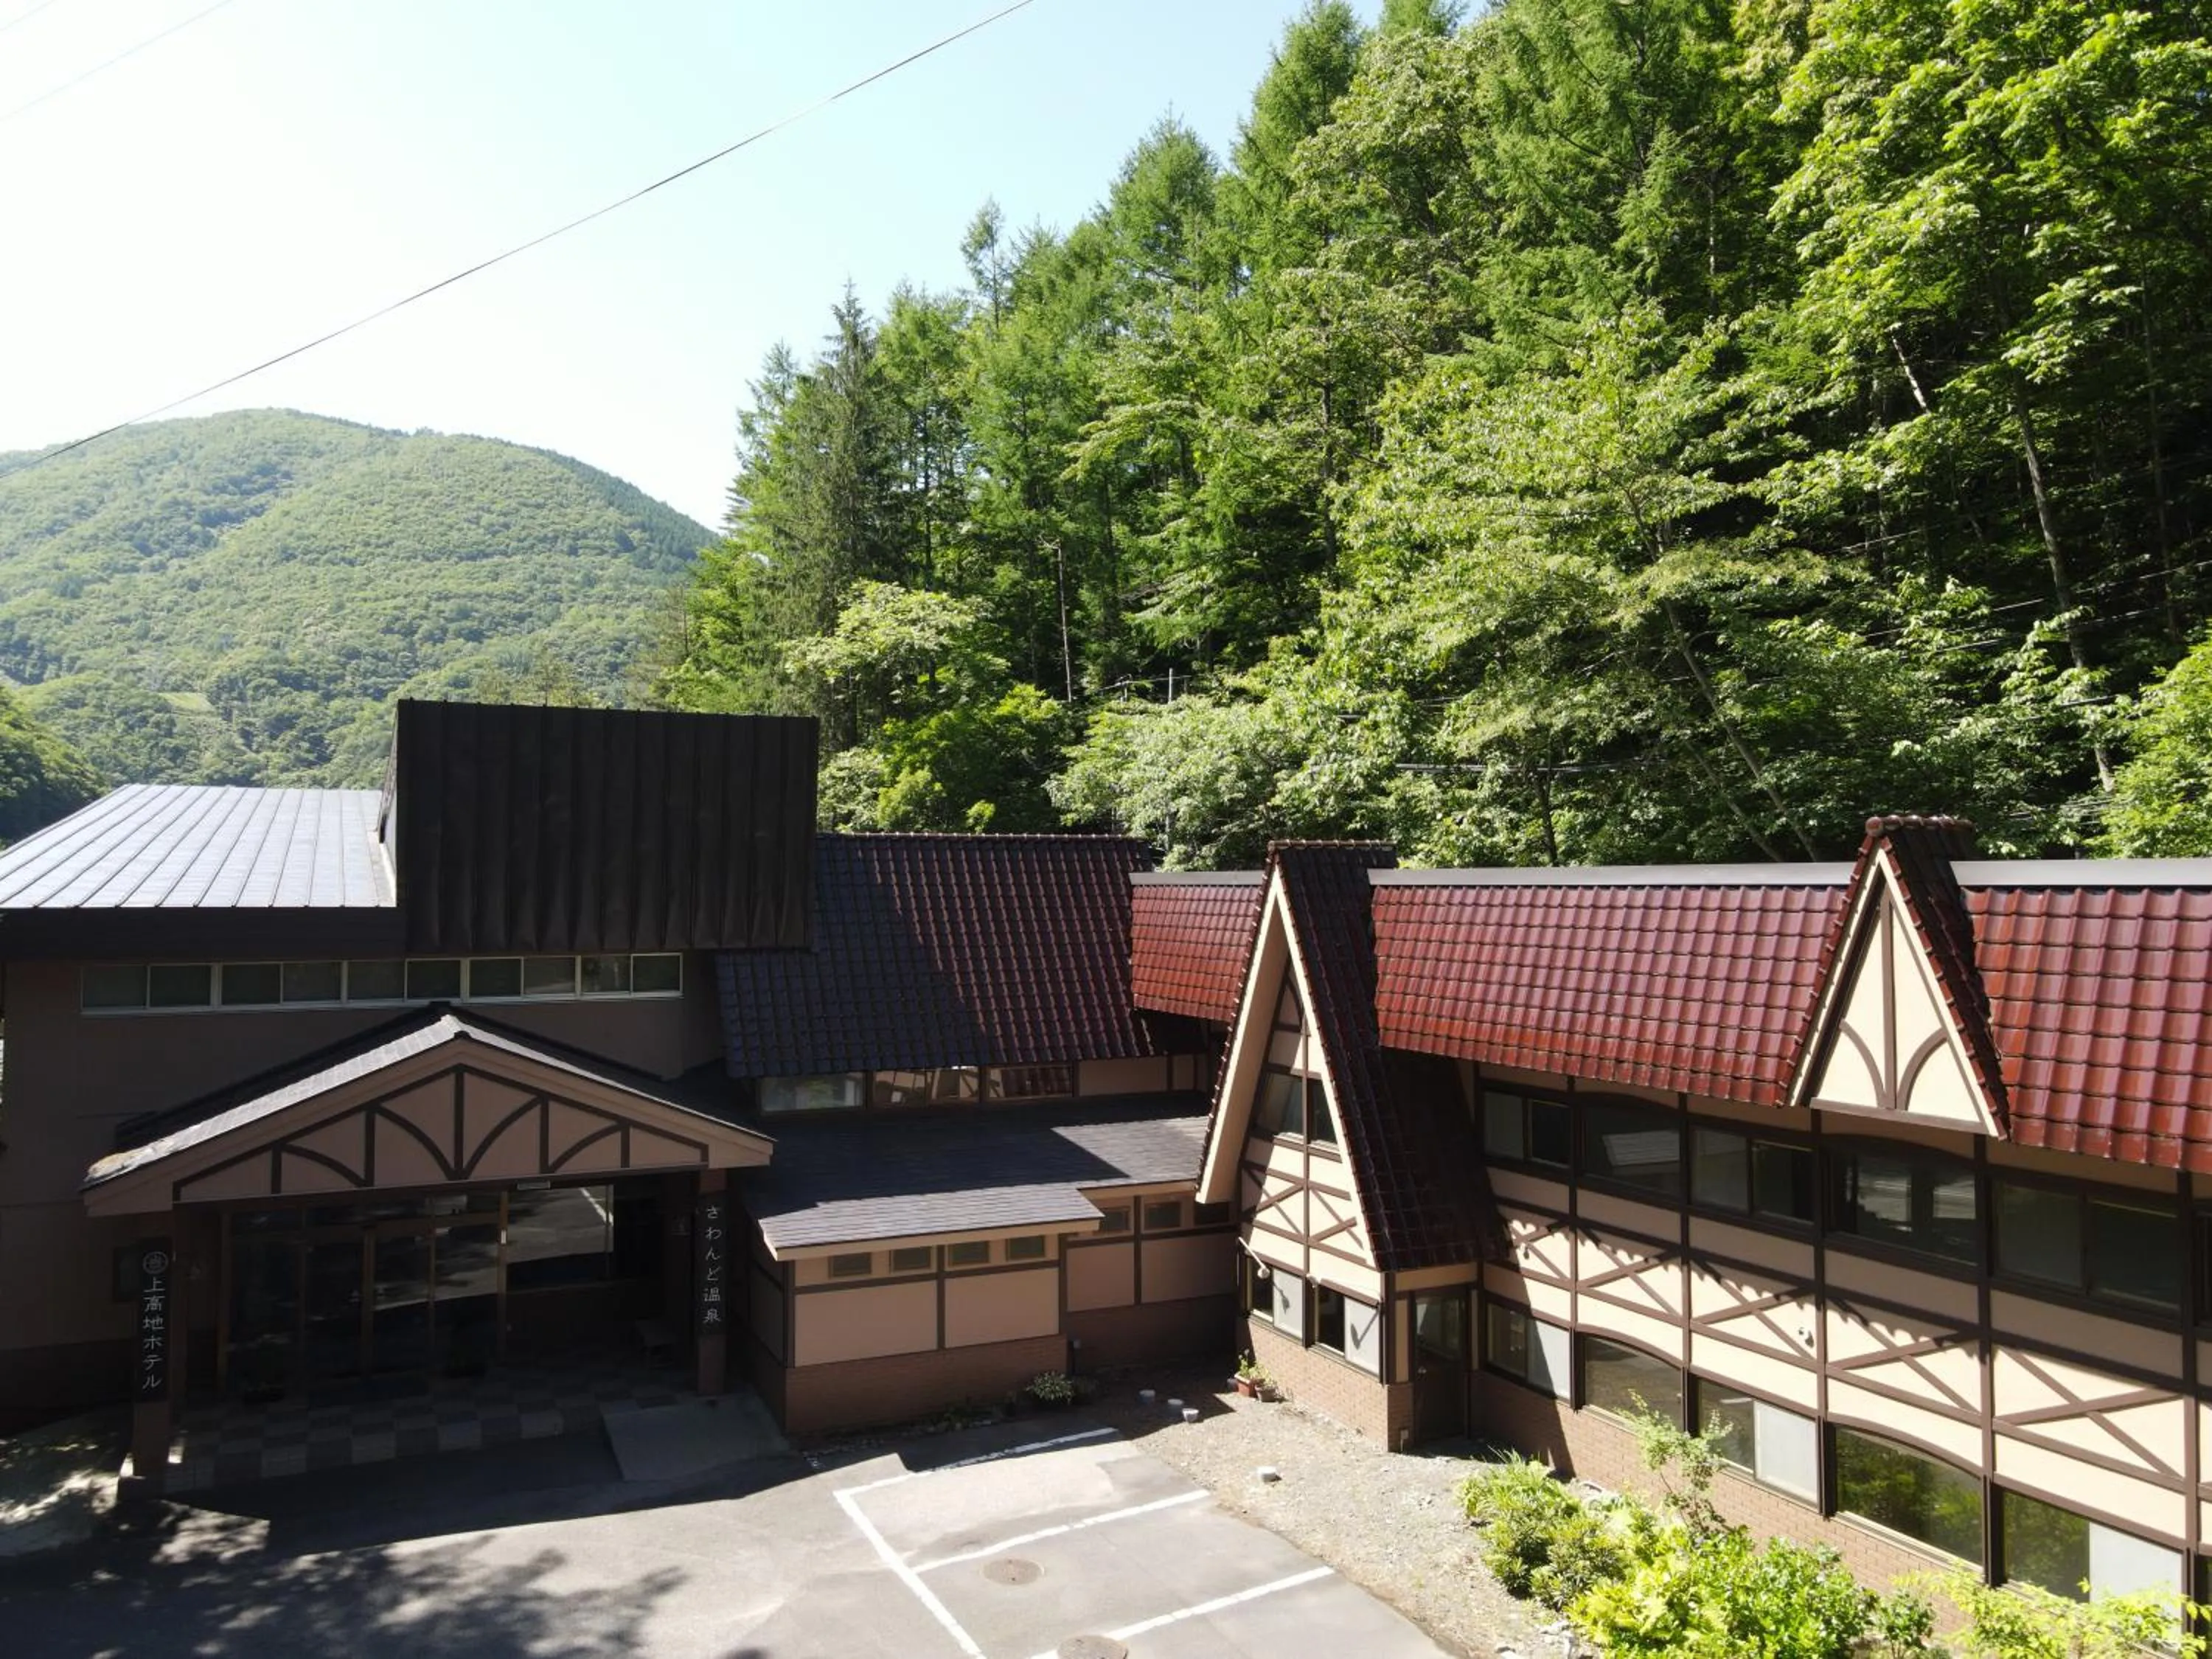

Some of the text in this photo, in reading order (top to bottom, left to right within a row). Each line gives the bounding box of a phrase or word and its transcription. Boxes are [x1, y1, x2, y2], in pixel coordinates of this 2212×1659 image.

[703, 1206, 722, 1323] さわんど温泉
[142, 1276, 165, 1389] 上高地ホテル
